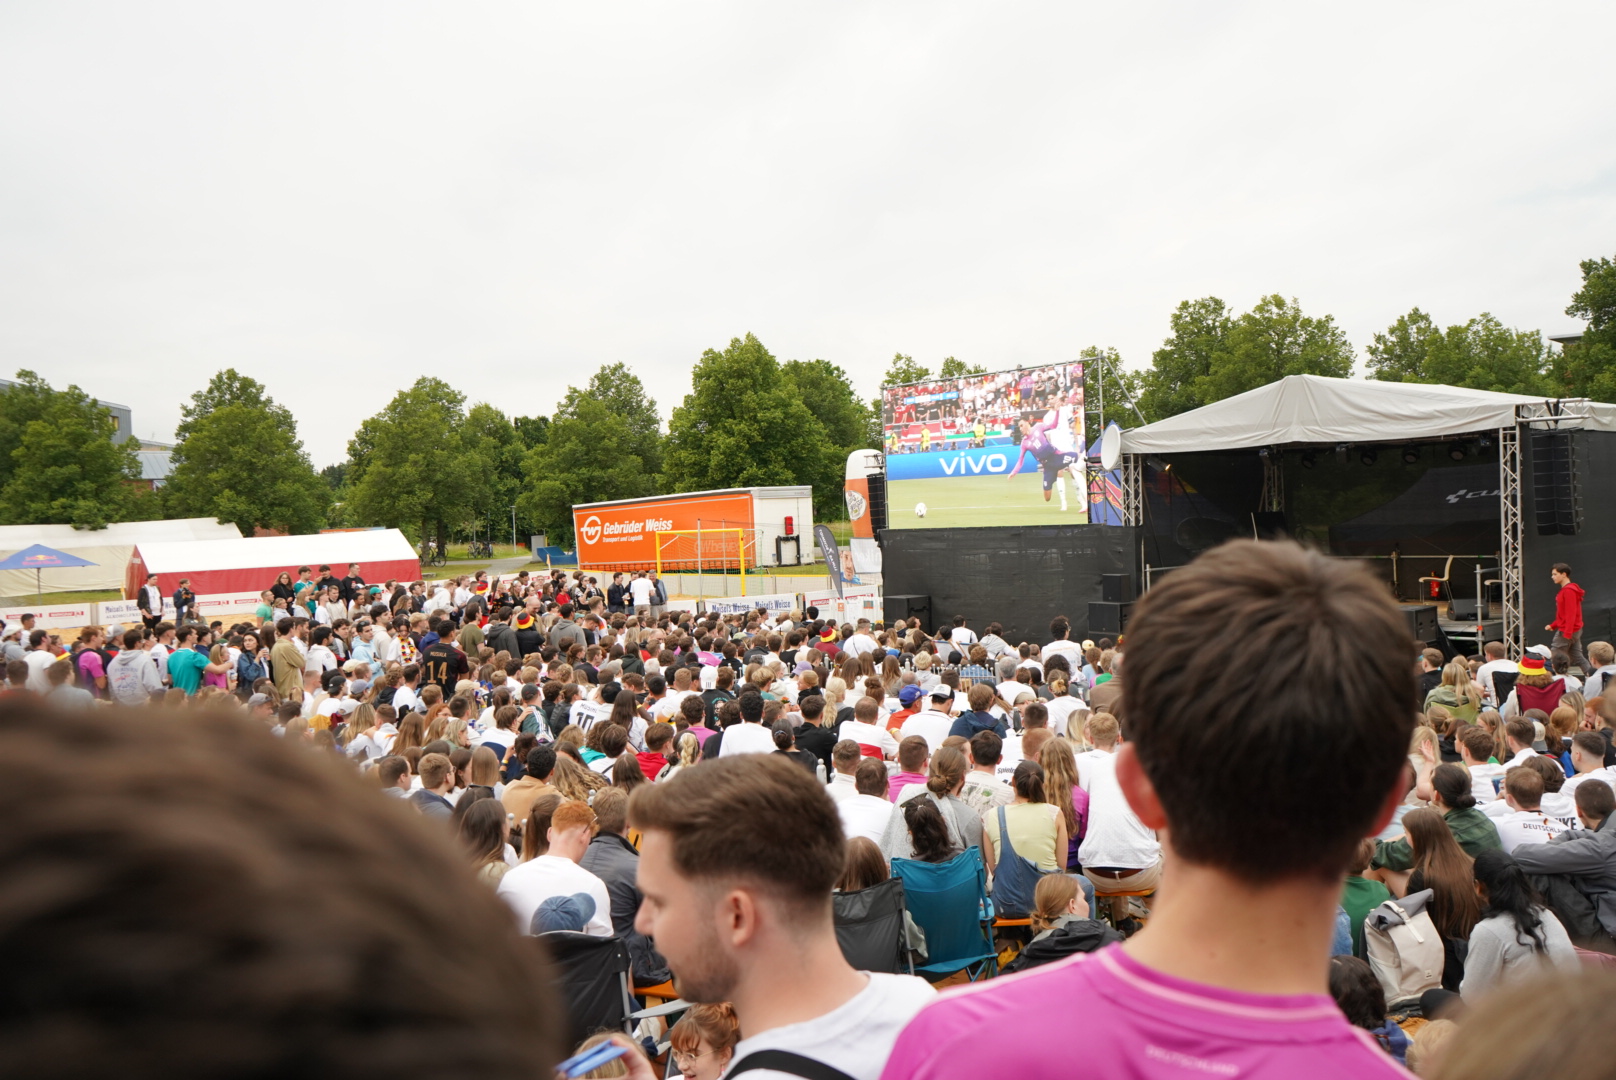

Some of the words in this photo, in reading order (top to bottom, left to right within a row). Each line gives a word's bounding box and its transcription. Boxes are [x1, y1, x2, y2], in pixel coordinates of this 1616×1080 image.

[939, 451, 1008, 476] vivo
[603, 520, 645, 535] Gebrüder
[645, 517, 673, 532] Weiss
[628, 534, 643, 542] Logistik
[774, 600, 791, 609] Weisse
[427, 660, 448, 685] 14
